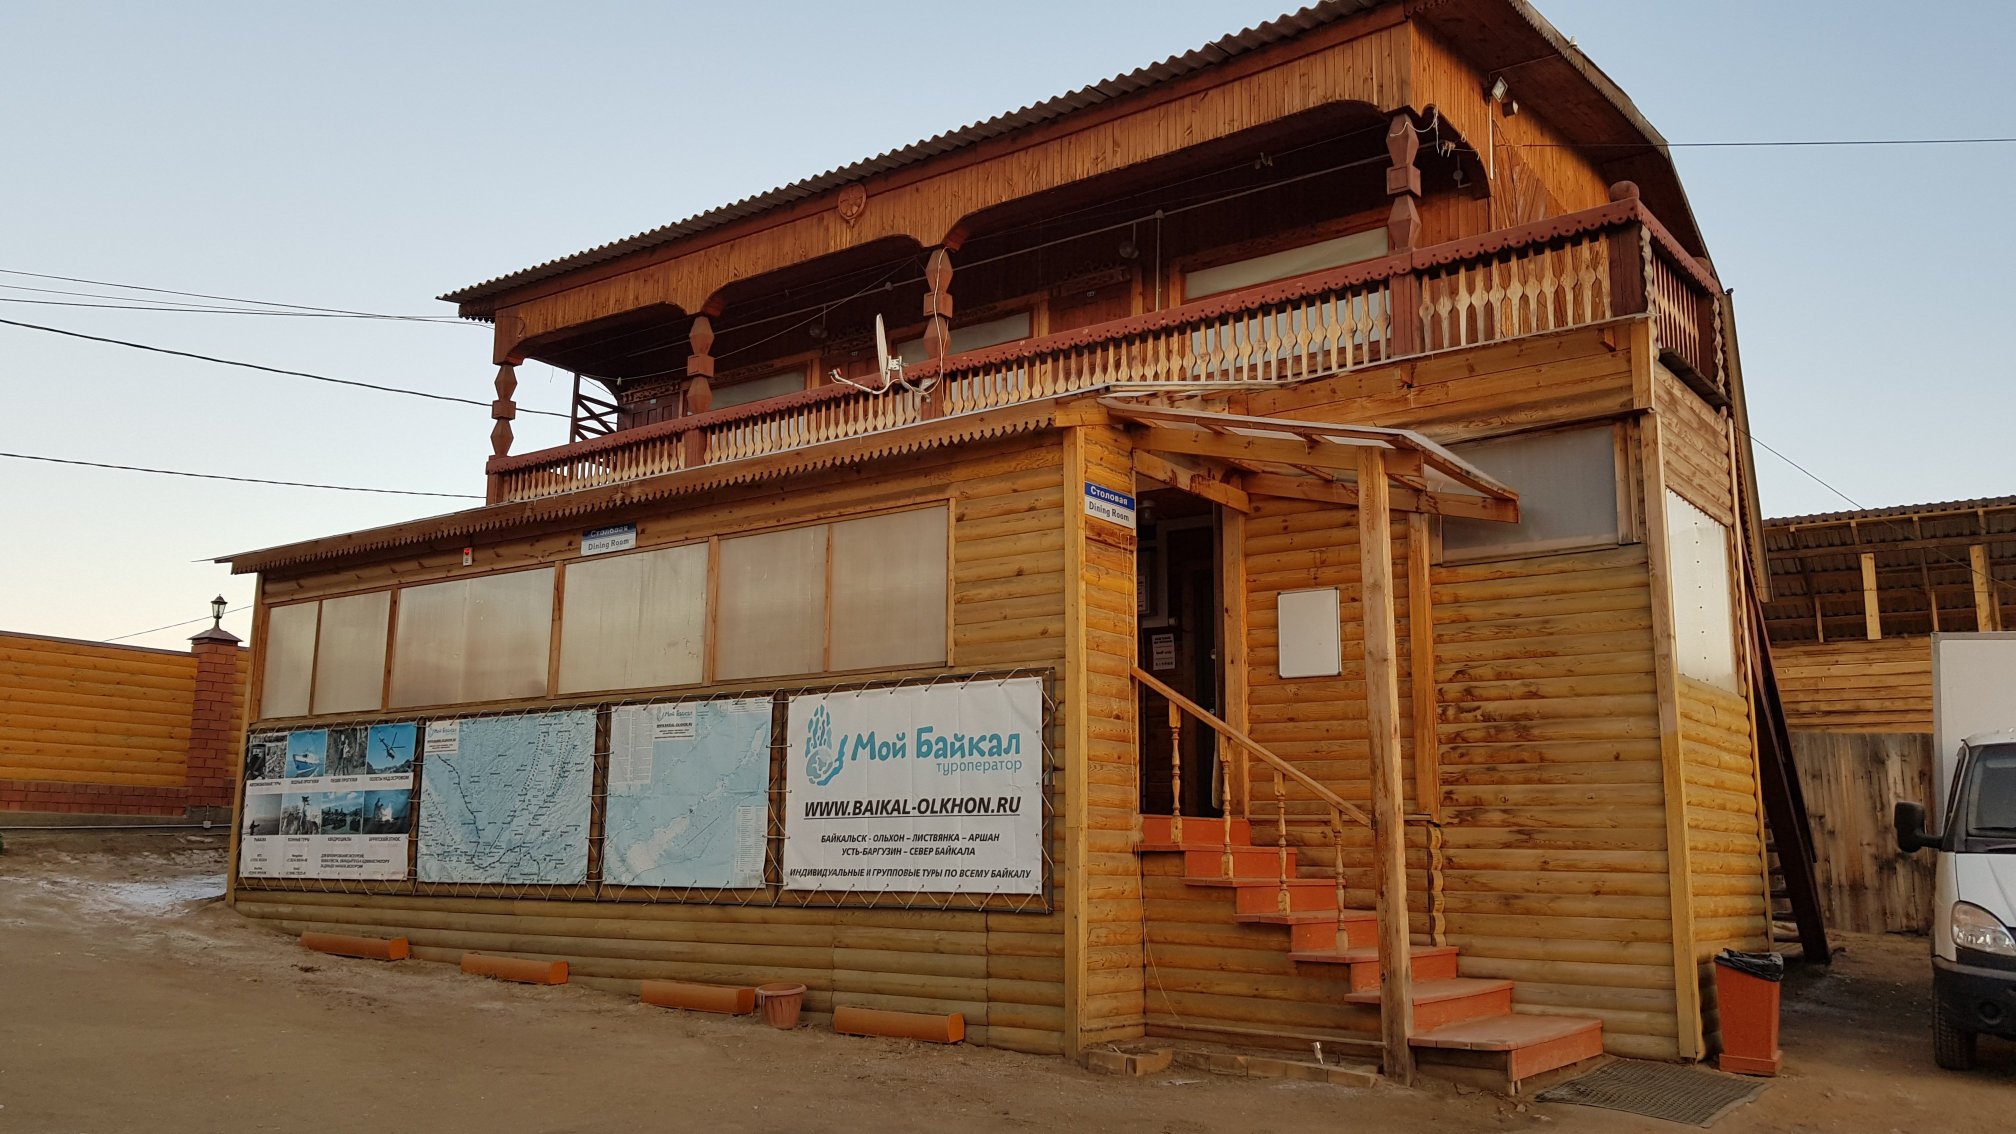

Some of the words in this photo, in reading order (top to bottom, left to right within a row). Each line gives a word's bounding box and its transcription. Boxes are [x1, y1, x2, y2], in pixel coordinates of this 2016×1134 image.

[1090, 486, 1128, 505] Столовая
[1089, 501, 1110, 518] Dining
[1111, 508, 1130, 521] Room
[588, 541, 610, 551] Dining
[611, 538, 630, 547] Room
[850, 731, 907, 761] Мой
[915, 725, 1021, 760] Байкал
[936, 759, 1023, 776] туроператор
[804, 796, 1021, 818] WWW.BAIKAL-OLKHON.RU
[820, 833, 867, 843] БАЙКАЛЬСК
[872, 834, 905, 842] ОЛЬХОН
[911, 833, 960, 842] ЛИСТВЯНКА
[967, 833, 1000, 842] АРШАН
[841, 847, 902, 856] УСТЬ-БАРГУЗИН
[909, 847, 934, 856] СЕВЕР
[934, 845, 976, 856] БАЙКАЛА
[789, 868, 865, 877] ИНДИВИДУАЛЬНЫЕ
[866, 868, 872, 877] И
[872, 868, 921, 877] ГРУППОВЫЕ
[922, 868, 943, 877] ТУРЫ
[944, 868, 958, 878] ПО
[959, 869, 990, 878] ВСЕМУ
[990, 867, 1032, 878] БАЙКАЛУ
